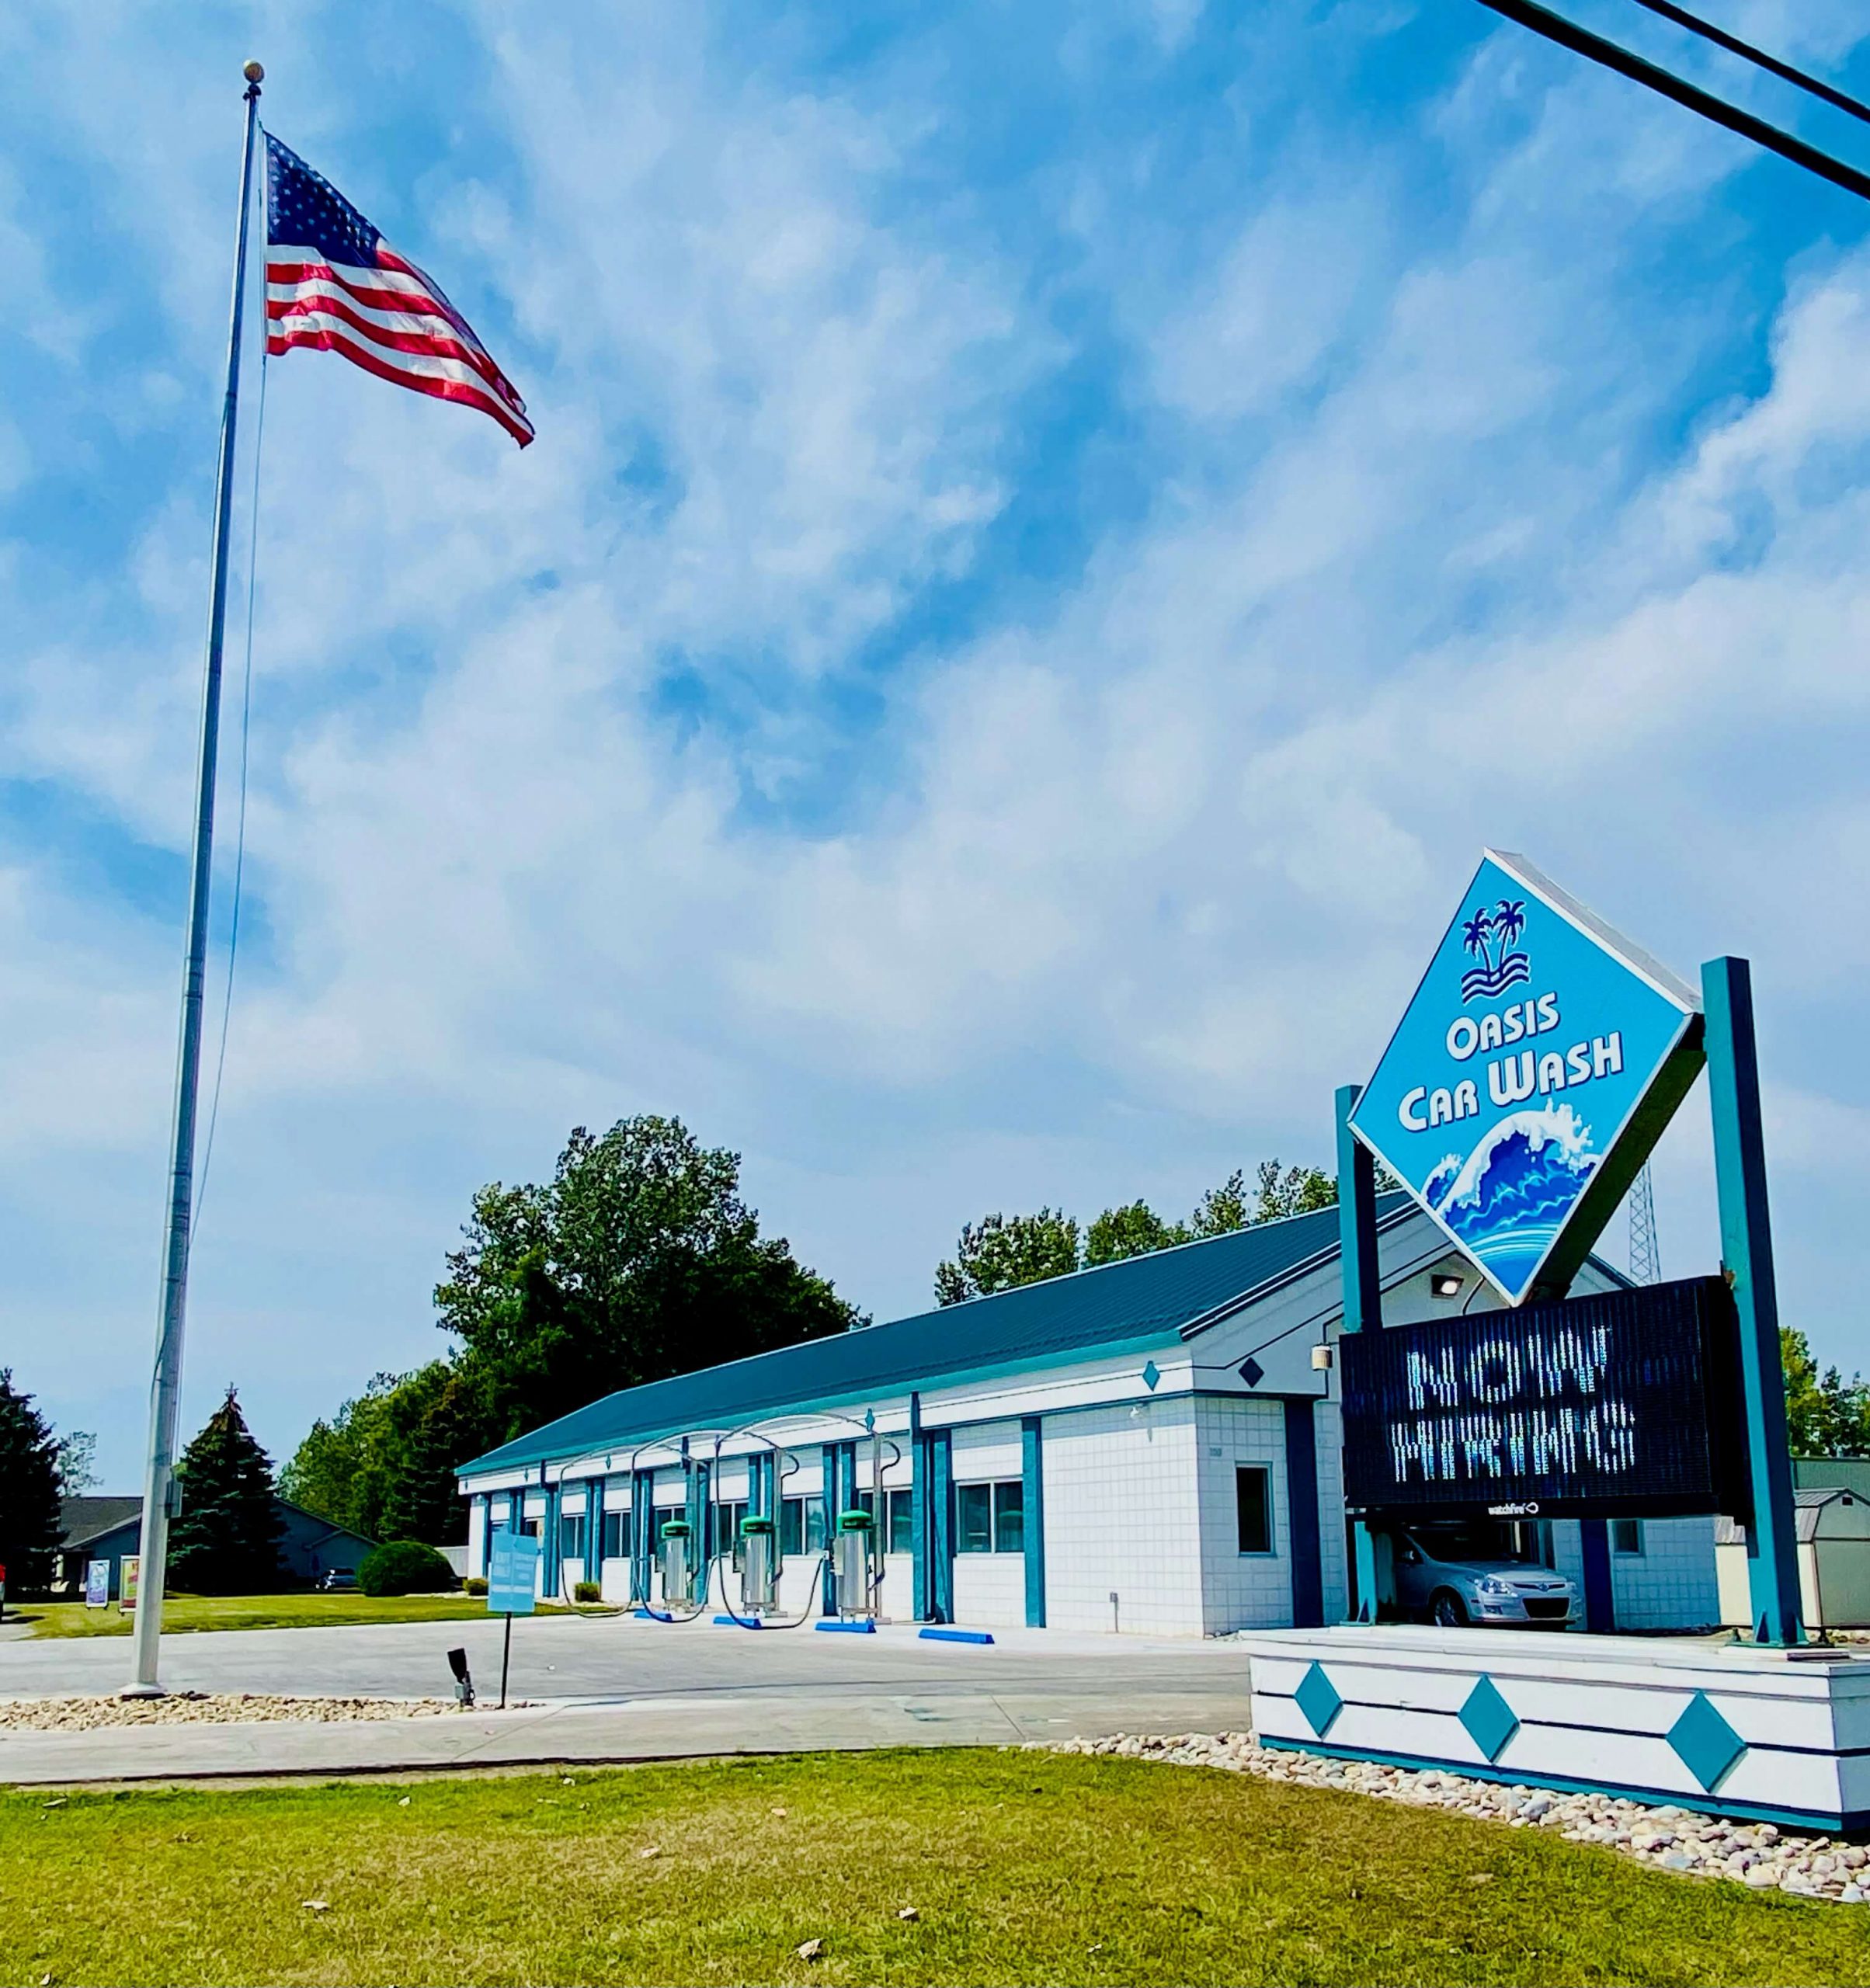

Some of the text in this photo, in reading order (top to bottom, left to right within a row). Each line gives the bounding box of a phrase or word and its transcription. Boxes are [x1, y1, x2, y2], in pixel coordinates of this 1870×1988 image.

[1446, 992, 1560, 1062] OASIS
[1398, 1031, 1623, 1131] CAR WASH
[1406, 1325, 1609, 1410] NOW
[1391, 1400, 1635, 1482] HIRING
